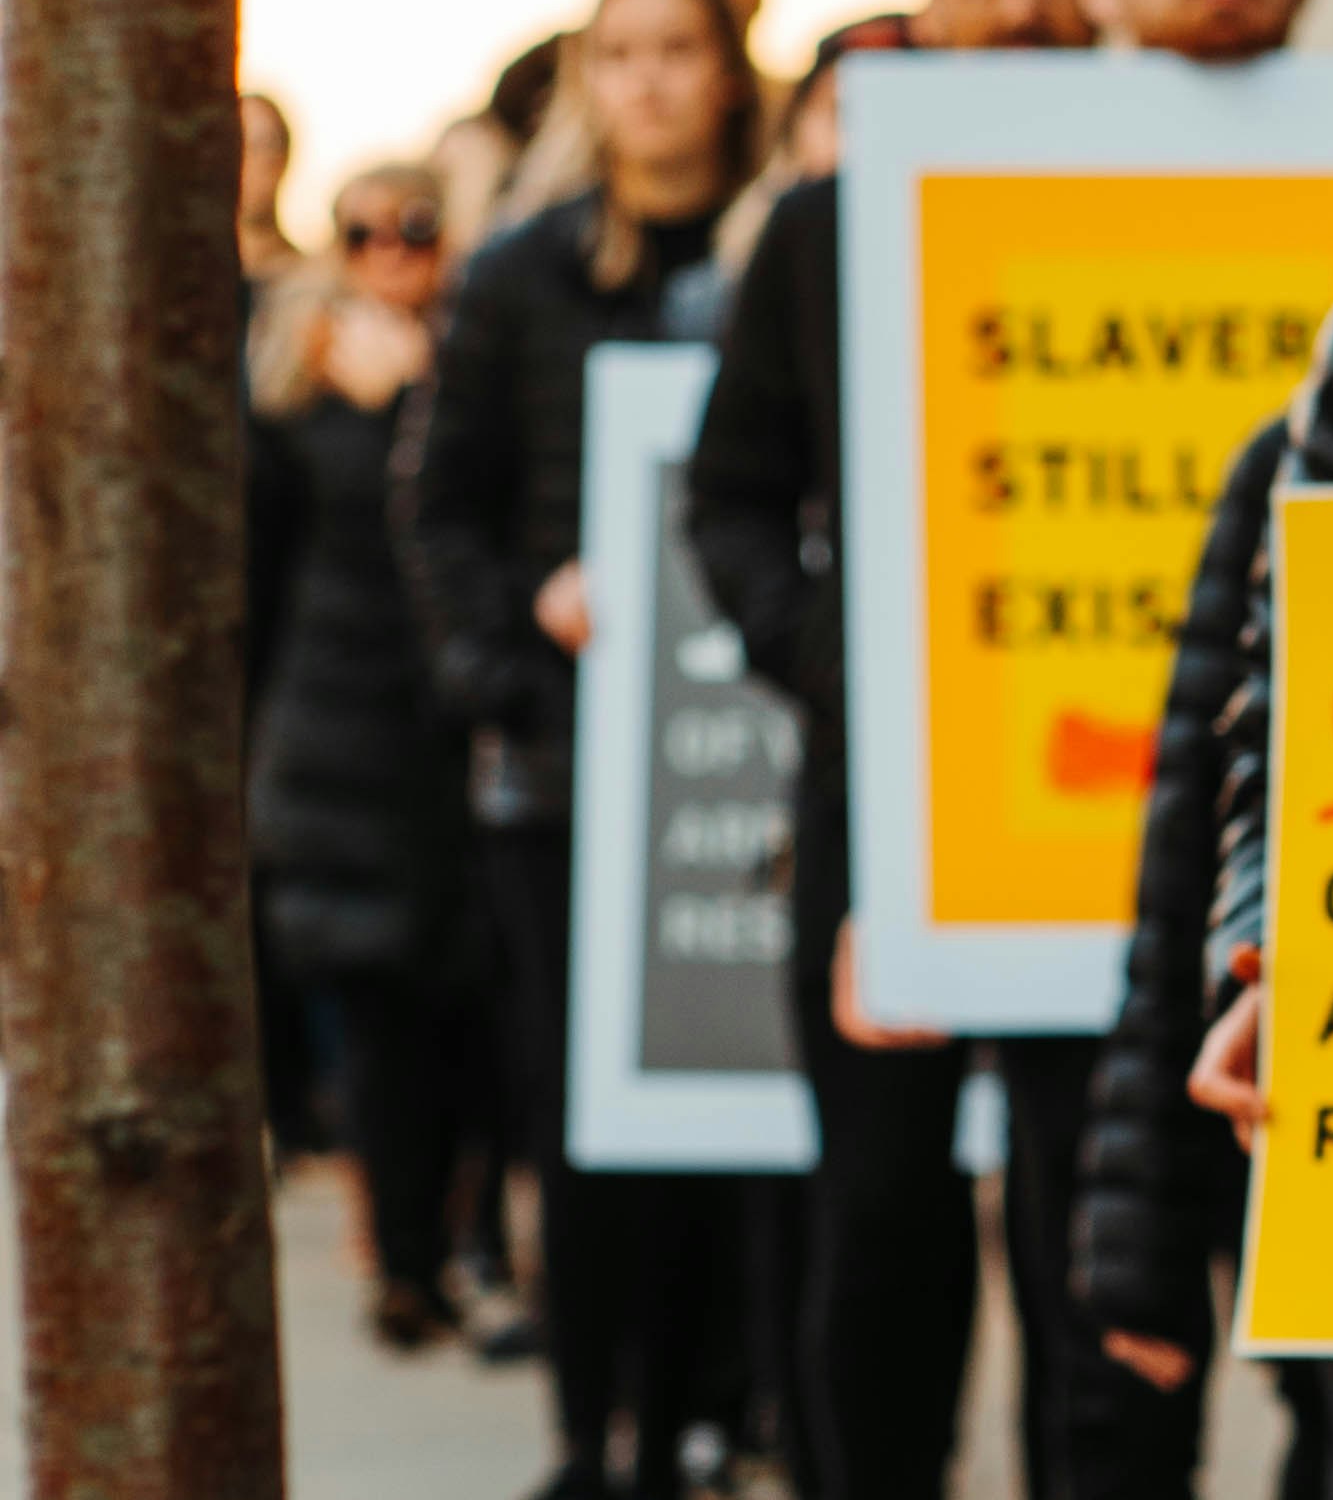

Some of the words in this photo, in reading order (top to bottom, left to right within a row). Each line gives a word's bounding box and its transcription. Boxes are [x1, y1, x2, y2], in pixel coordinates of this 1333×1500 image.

[972, 309, 1311, 378] SLAVER
[972, 442, 1220, 512] STILL
[972, 576, 1168, 646] EXIS
